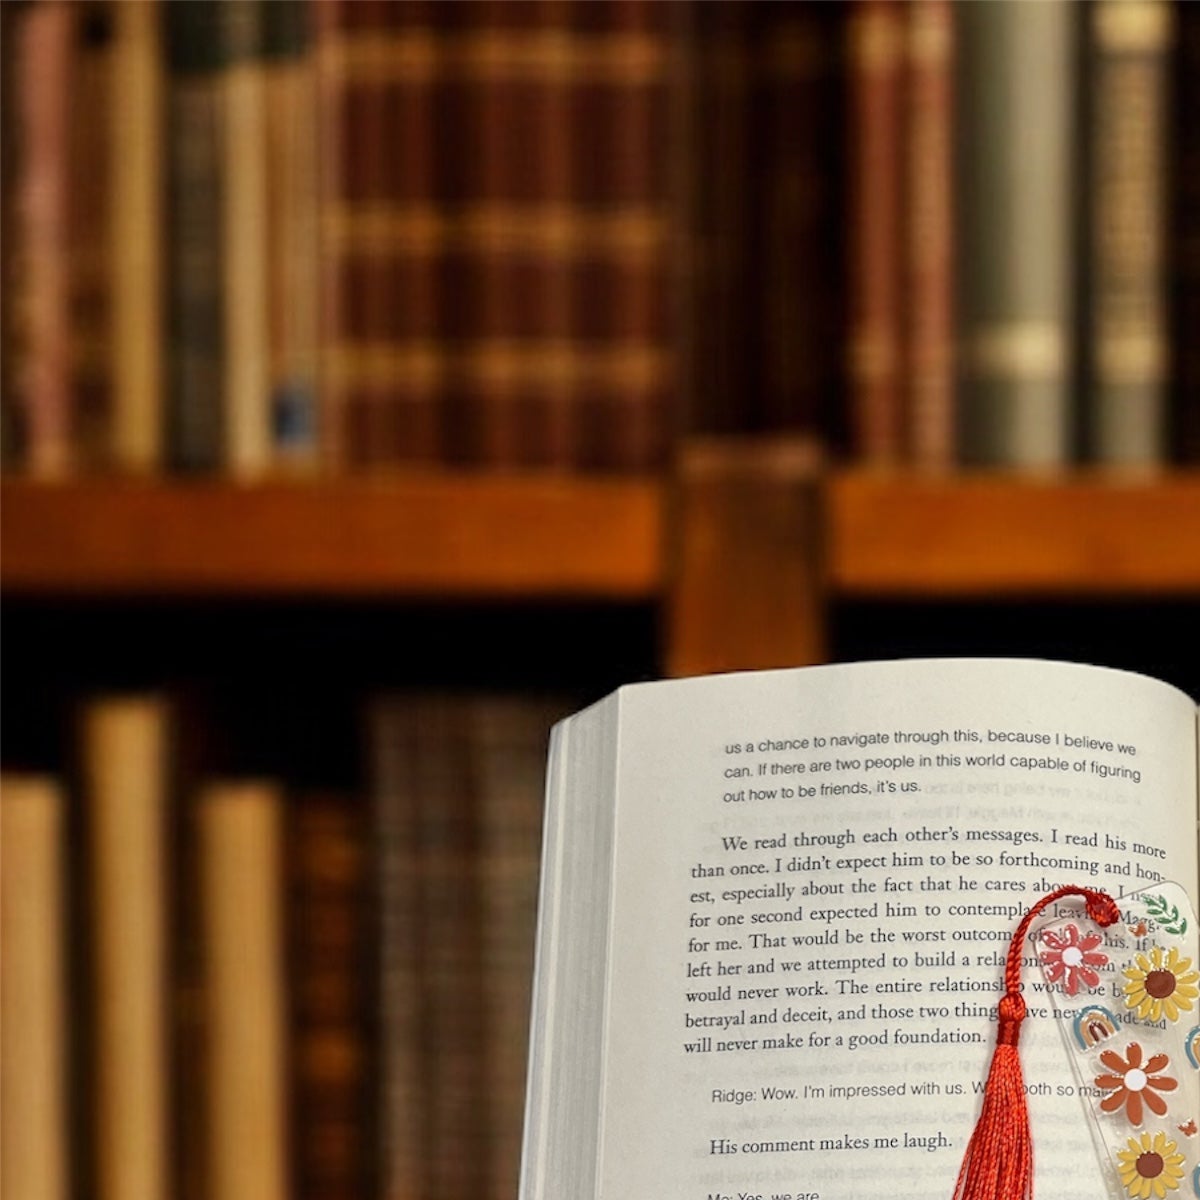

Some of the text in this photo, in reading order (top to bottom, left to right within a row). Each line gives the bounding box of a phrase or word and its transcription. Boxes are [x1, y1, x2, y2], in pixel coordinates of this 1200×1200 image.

[725, 743, 742, 755] us
[745, 742, 754, 753] a
[758, 738, 809, 752] chance
[813, 736, 826, 748] to
[830, 732, 890, 748] navigate
[894, 729, 949, 746] through
[954, 728, 982, 744] this,
[988, 729, 1051, 745] because
[1064, 733, 1114, 752] believe
[1117, 743, 1136, 757] we
[723, 779, 921, 804] out how to be friends, it's us.
[721, 836, 748, 852] We
[754, 832, 786, 850] read
[794, 828, 856, 849] through
[862, 826, 898, 843] each
[905, 826, 959, 842] other's
[965, 830, 1043, 846] messages.
[1065, 832, 1098, 848] read
[1105, 833, 1126, 852] his
[1133, 843, 1166, 860] more
[684, 1027, 986, 1054] will never make for a good foundation.
[710, 1131, 952, 1155] His comment makes me laugh.
